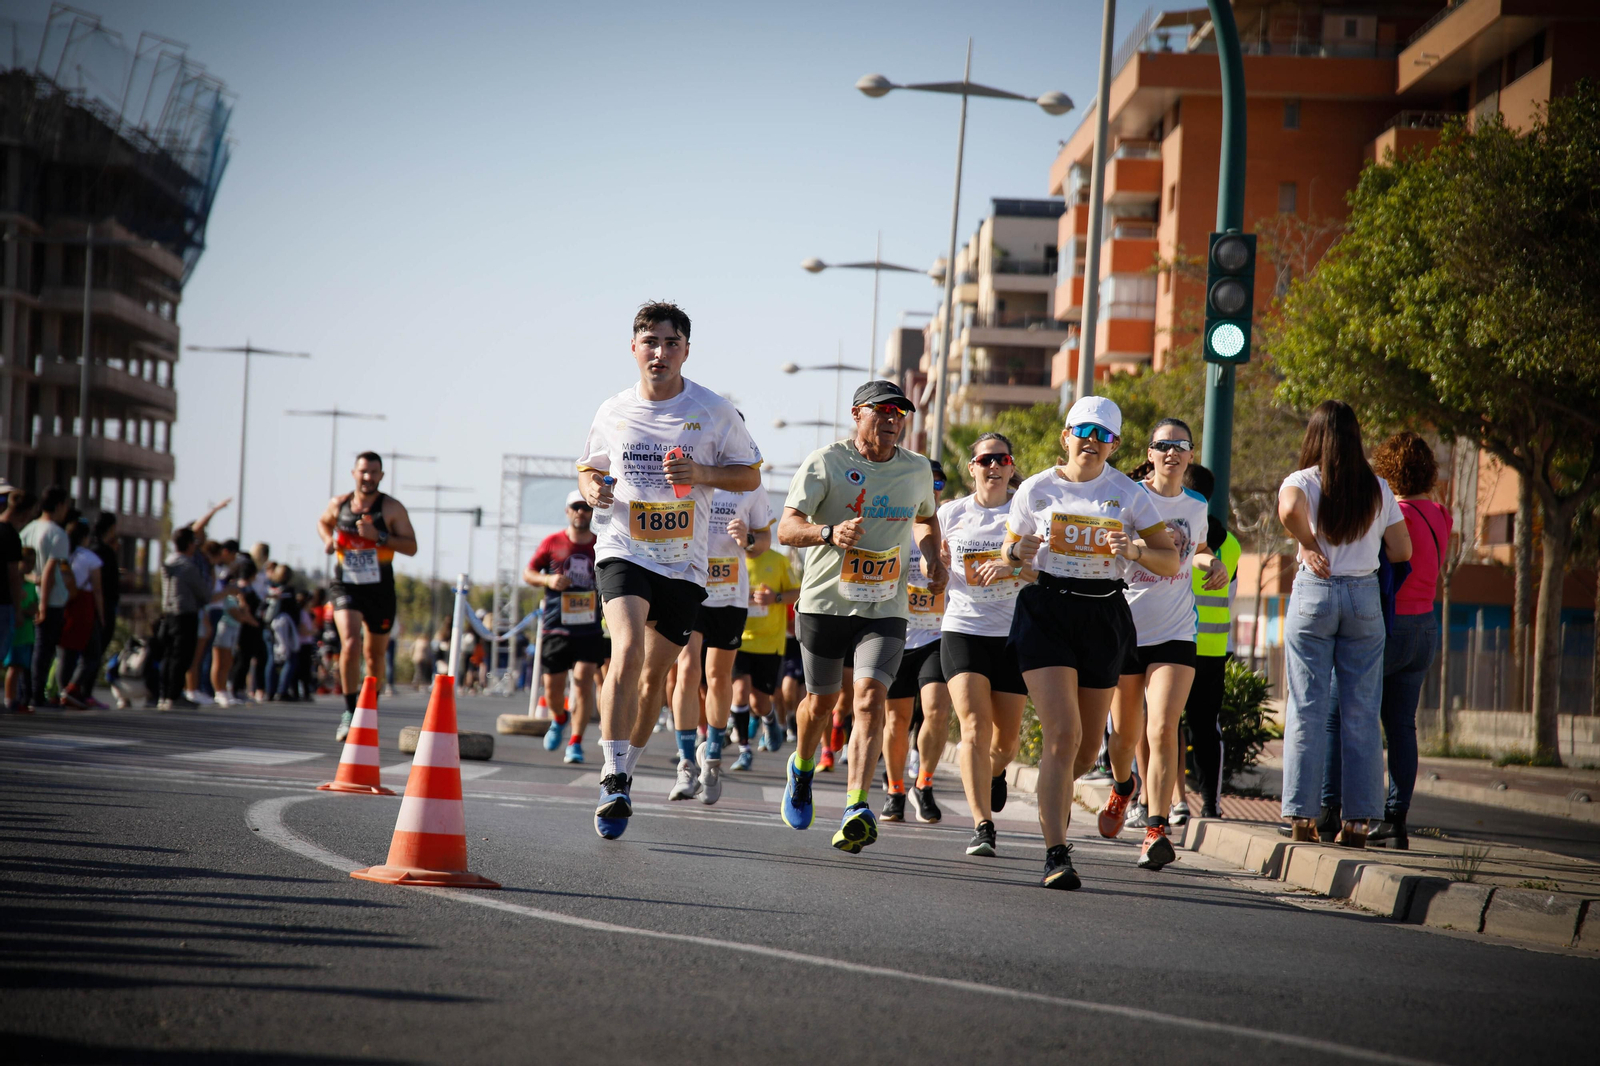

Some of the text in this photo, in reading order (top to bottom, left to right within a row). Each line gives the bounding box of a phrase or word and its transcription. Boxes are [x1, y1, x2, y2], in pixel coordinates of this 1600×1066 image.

[621, 443, 694, 452] Medio Marón
[622, 451, 662, 462] Almería
[623, 463, 646, 471] RAMÓN
[711, 500, 738, 508] aratón
[714, 506, 736, 515] 2024
[862, 506, 915, 519] TRAINING
[636, 510, 690, 531] 1880
[1064, 524, 1108, 547] 916
[956, 545, 990, 554] Almerí
[982, 540, 1003, 548] Mara
[345, 555, 374, 567] 5205
[850, 557, 897, 576] 1077
[1131, 570, 1158, 583] Elisa,
[569, 598, 590, 608] 842
[908, 593, 936, 607] 351
